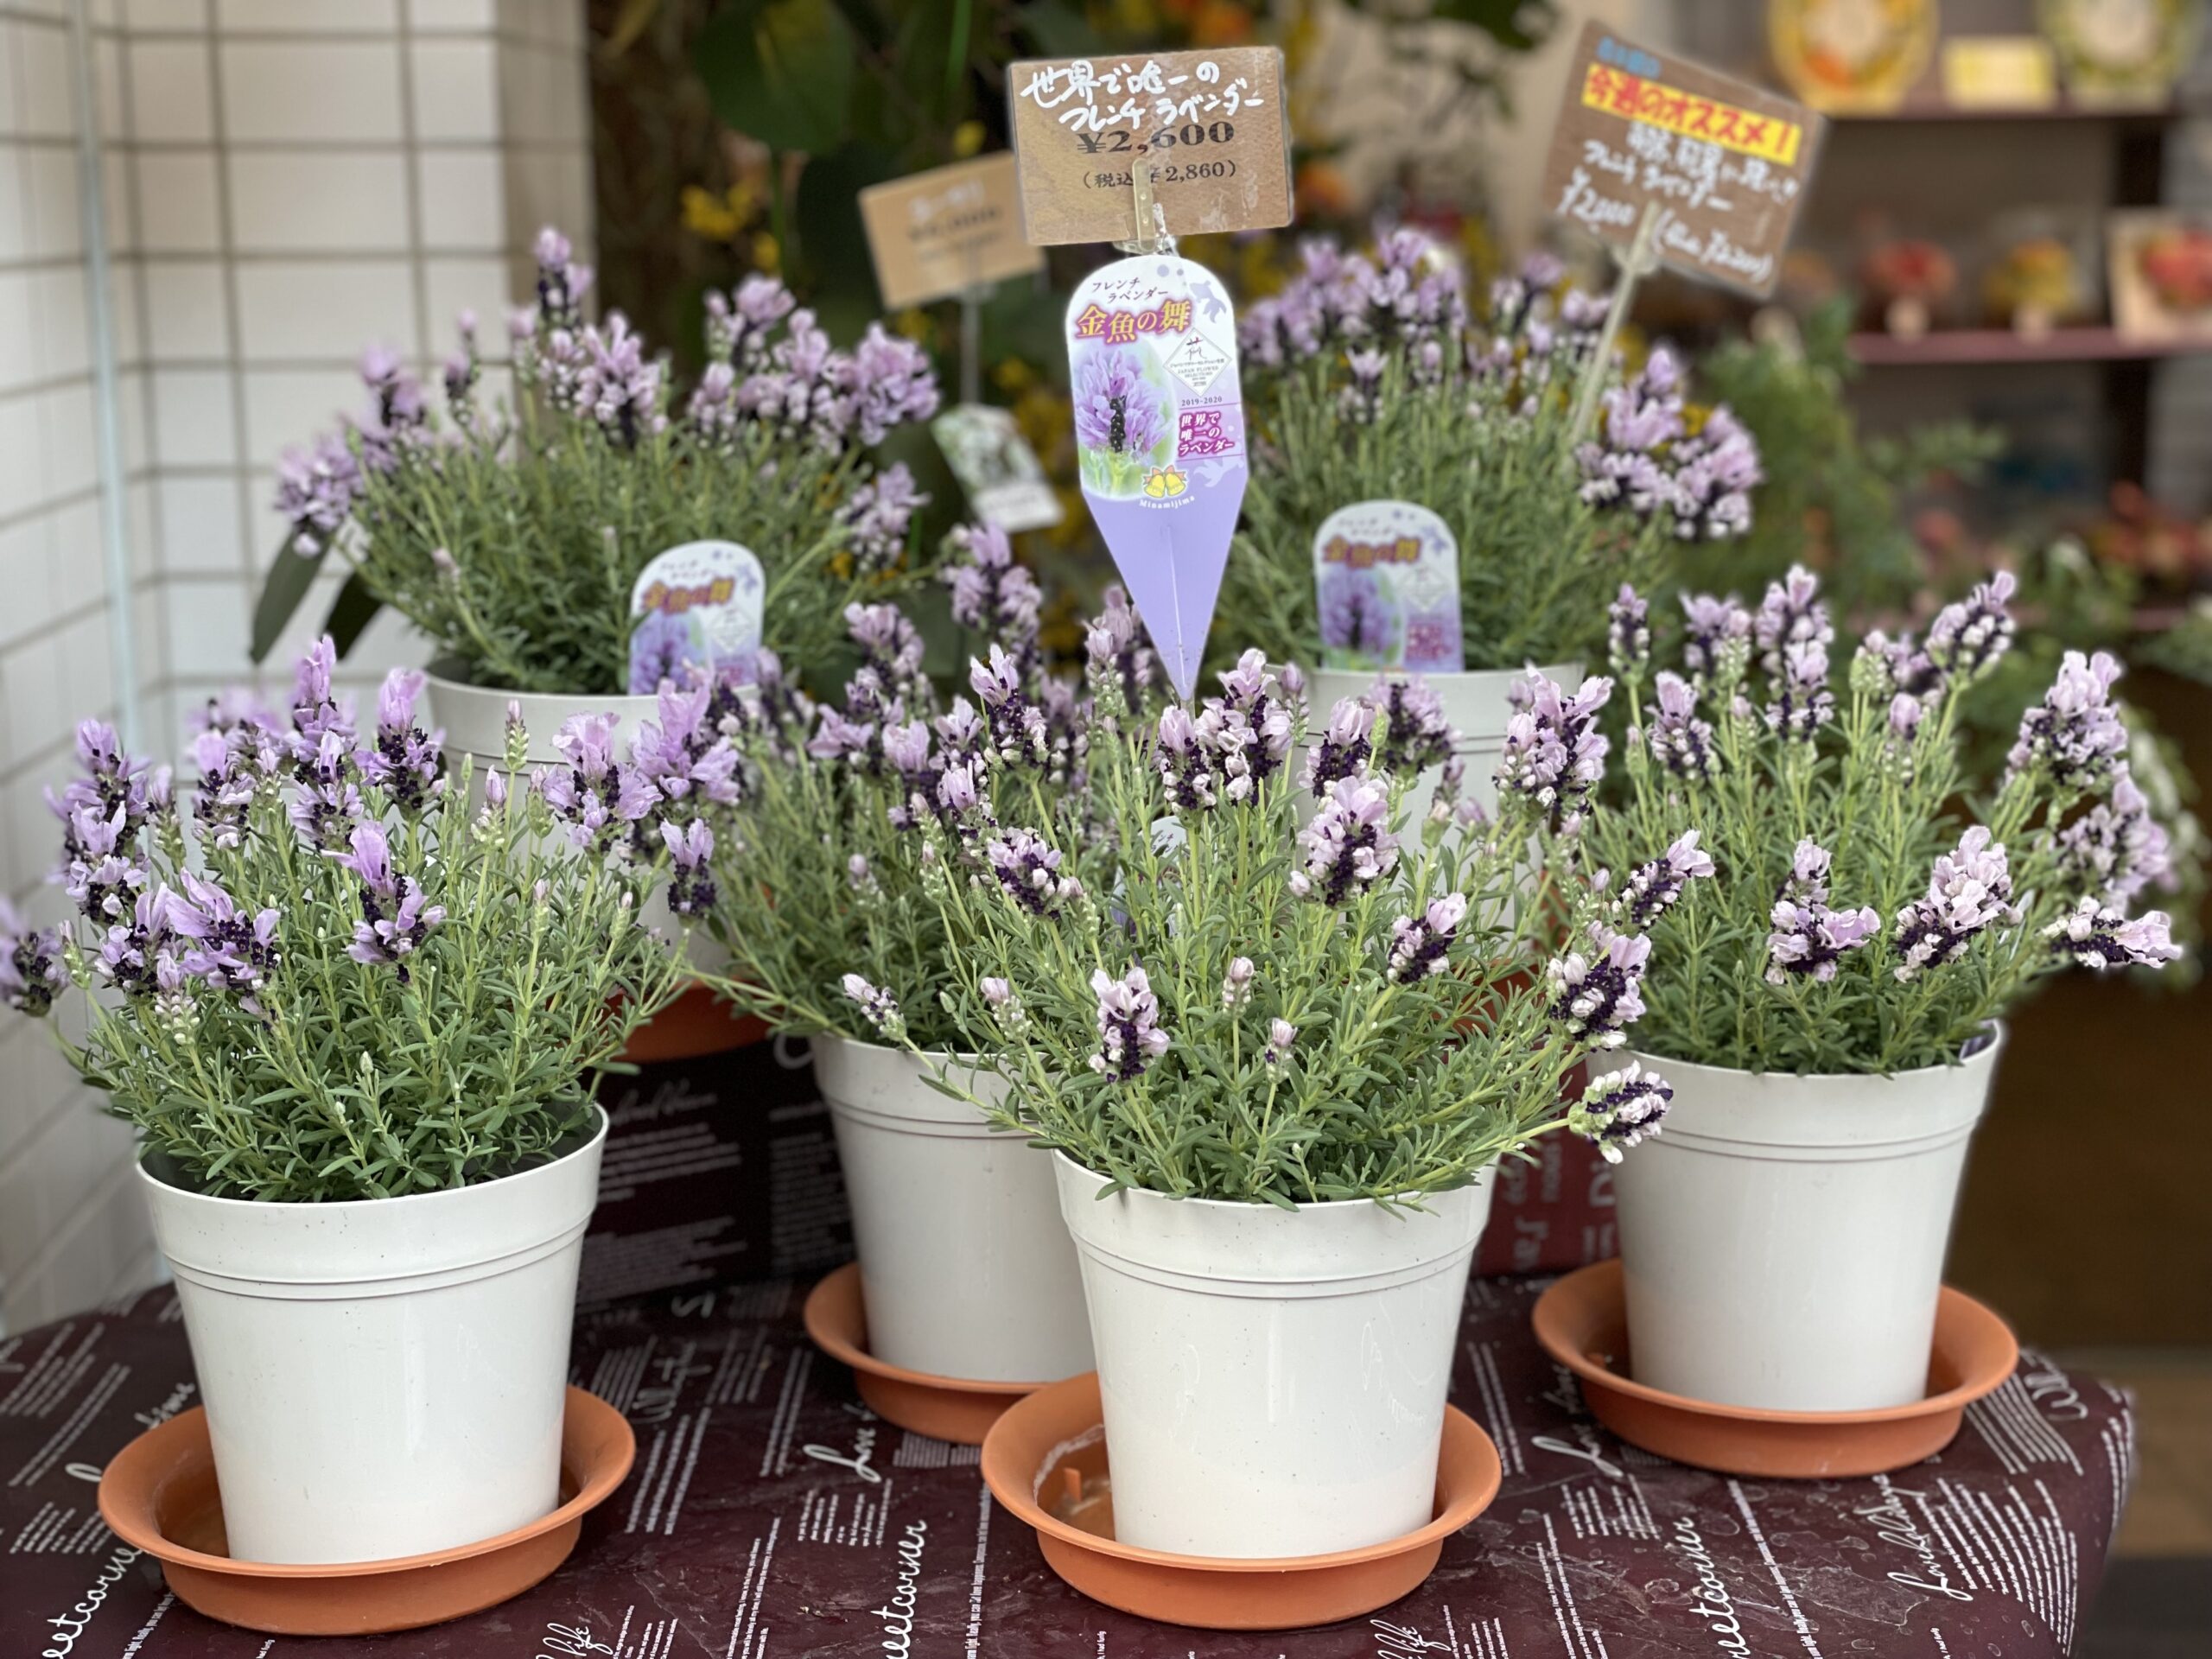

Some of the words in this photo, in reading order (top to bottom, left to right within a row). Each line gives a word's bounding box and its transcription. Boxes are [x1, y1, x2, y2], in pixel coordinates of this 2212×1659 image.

[1020, 60, 1220, 109] 世界で唯一の
[1058, 98, 1146, 131] フレンチ
[1155, 76, 1264, 125] ラベンダー
[1077, 121, 1236, 154] ¥2,600
[1092, 276, 1141, 293] フレンチ
[1107, 287, 1169, 303] ラベンダー
[1076, 301, 1192, 344] 金魚の舞
[1181, 397, 1223, 406] 2019-2020
[1180, 412, 1221, 428] 世界で
[1180, 428, 1221, 442] 唯一の
[1179, 440, 1234, 456] ラベンダー
[1139, 496, 1195, 509] Minamijima
